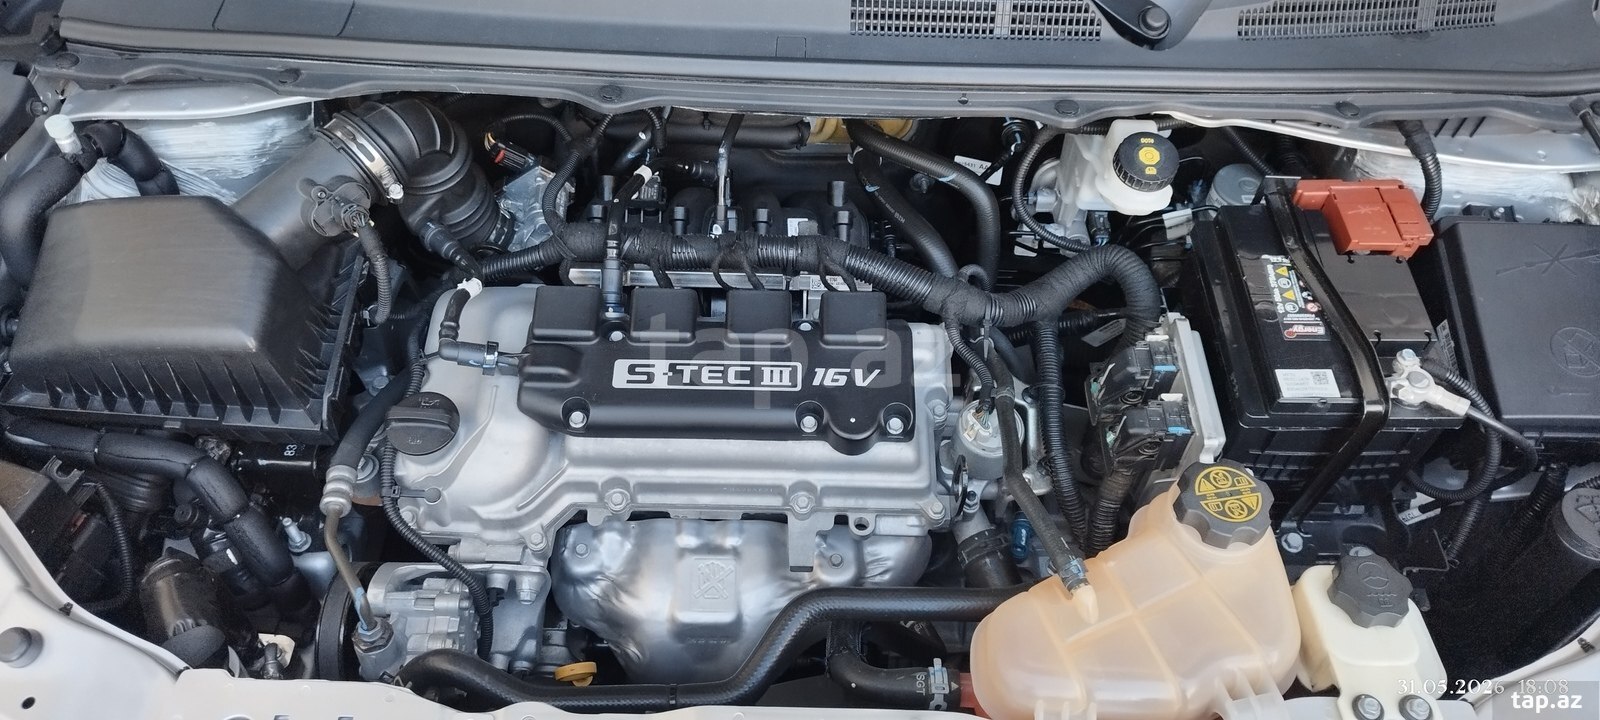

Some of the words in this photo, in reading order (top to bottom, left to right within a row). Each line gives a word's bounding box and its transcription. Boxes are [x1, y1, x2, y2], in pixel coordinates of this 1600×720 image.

[625, 363, 751, 385] S-TEC
[761, 366, 793, 386] III
[812, 367, 881, 387] 16V
[916, 673, 925, 695] SGT
